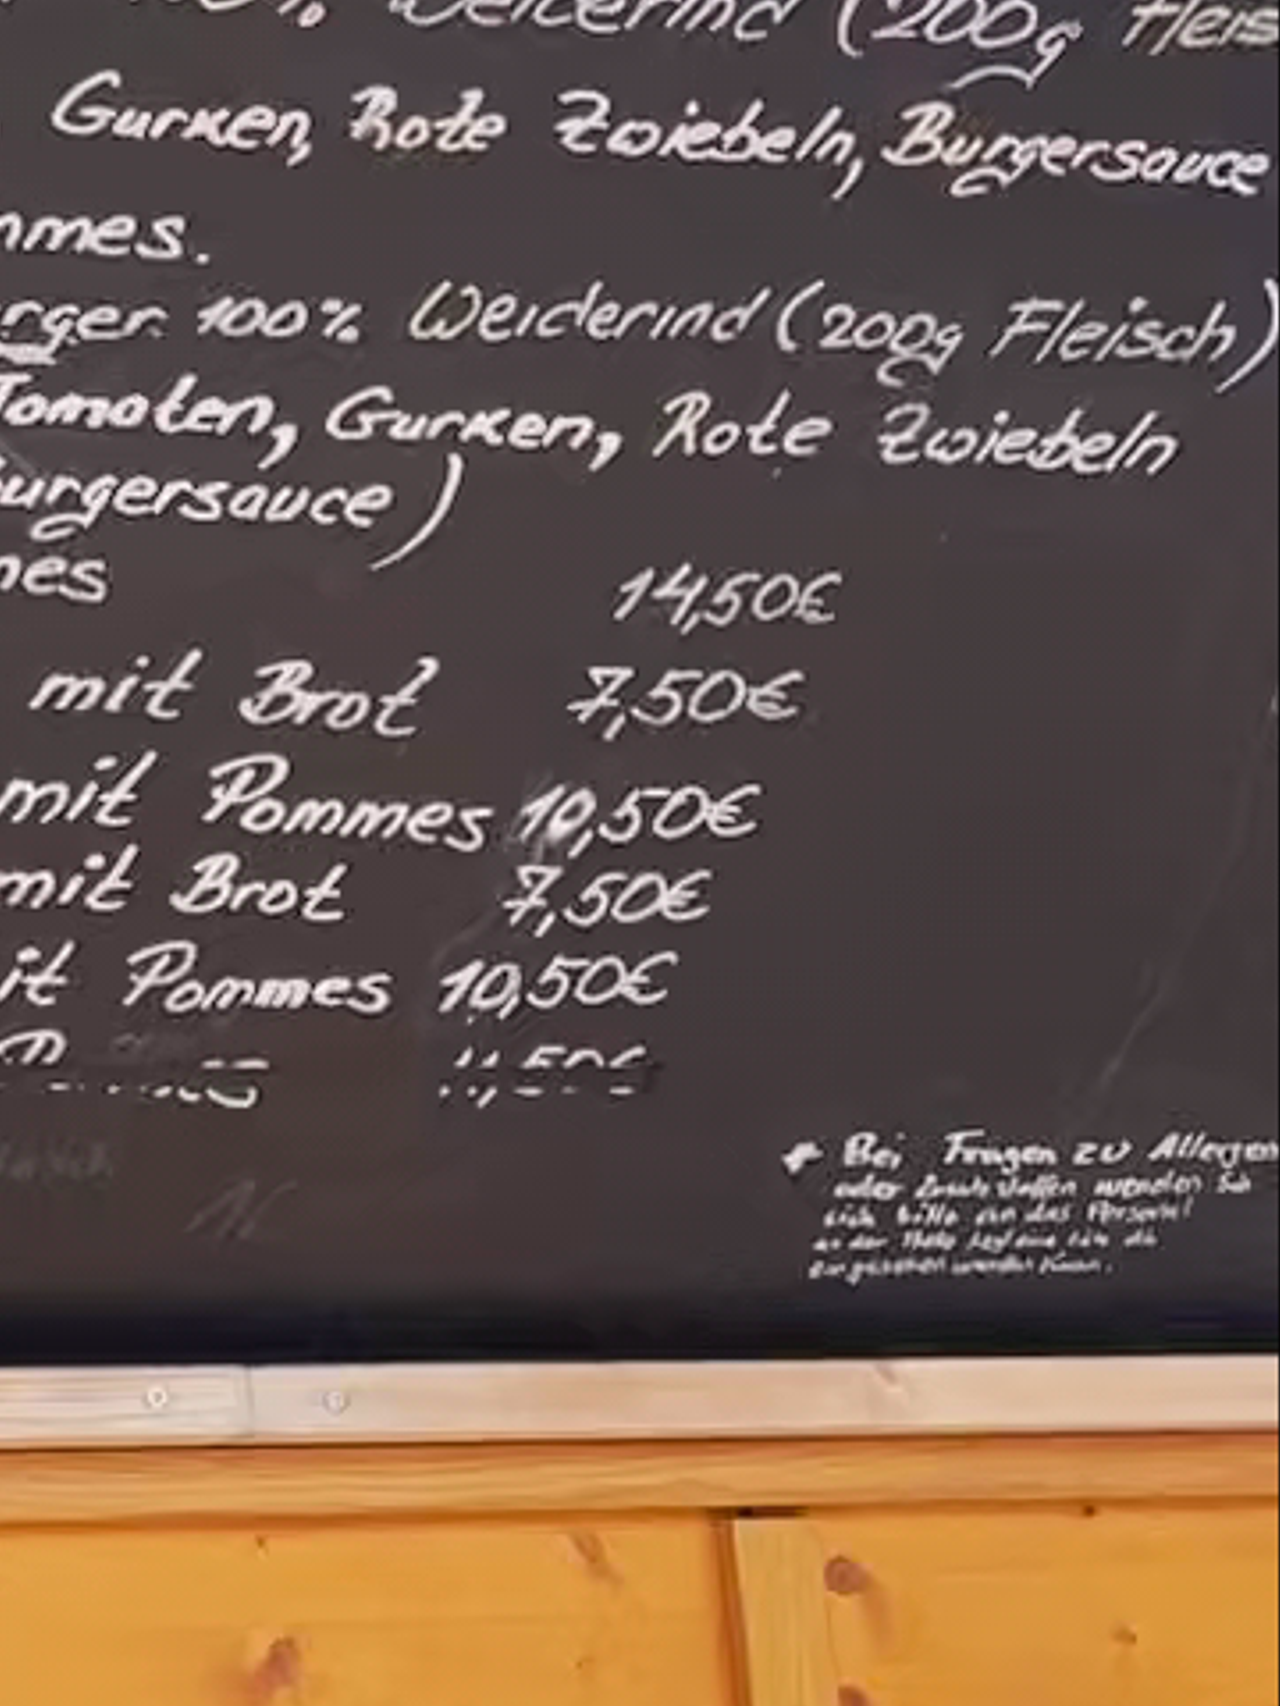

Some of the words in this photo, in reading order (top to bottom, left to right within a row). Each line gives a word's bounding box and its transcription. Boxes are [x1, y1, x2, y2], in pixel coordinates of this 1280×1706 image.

[48, 66, 316, 168] Gurken,
[345, 84, 512, 158] Rote
[550, 91, 872, 201] Zwiebeln,
[878, 98, 1275, 198] Burgersauce
[192, 291, 365, 348] 100%
[775, 274, 968, 391] (200g
[985, 276, 1278, 394] Fleisch)
[325, 381, 625, 471] Gurken,
[648, 386, 836, 462] Rote
[873, 401, 1182, 478] Zwiebeln
[608, 561, 848, 638] 14,50€
[25, 646, 208, 724] mit
[235, 654, 445, 741] Brot
[562, 662, 810, 746] 7,50€
[198, 750, 502, 854] Pommes
[514, 778, 768, 860] 10,50€
[168, 848, 352, 928] Brot
[500, 861, 718, 941] 7,50€
[118, 936, 395, 1018] Pommes
[435, 948, 685, 1024] 10,50€
[842, 1129, 908, 1171] Bei
[1070, 1139, 1134, 1168] zu
